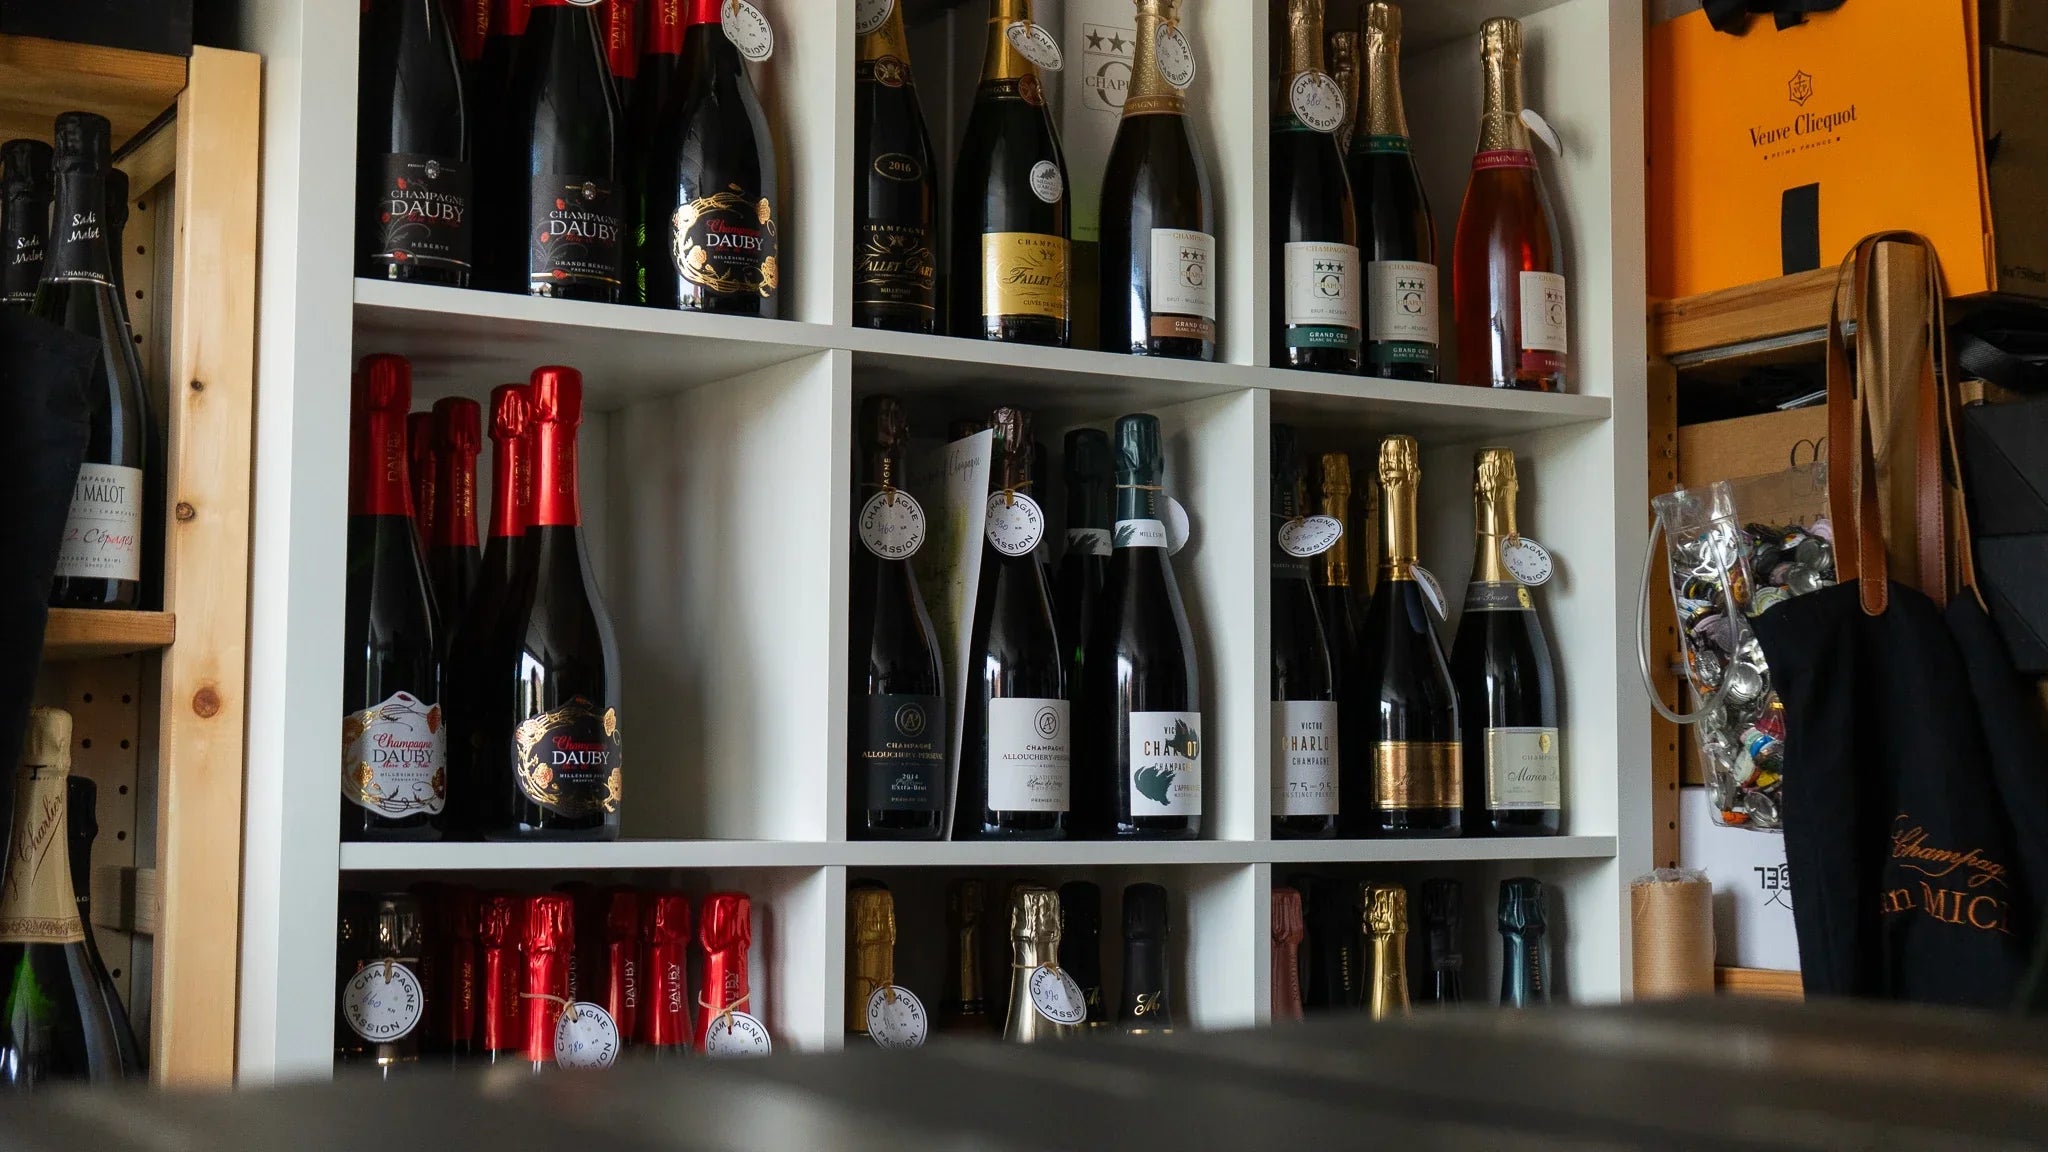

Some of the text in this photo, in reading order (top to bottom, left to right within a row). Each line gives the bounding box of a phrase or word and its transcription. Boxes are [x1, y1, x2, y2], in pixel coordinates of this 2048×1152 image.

[611, 2, 621, 49] DAUBY
[724, 3, 768, 34] CHPAGNE
[855, 7, 885, 30] SSION
[1157, 29, 1189, 61] CHAAGNE
[1160, 59, 1188, 81] PASSION
[1296, 77, 1341, 109] CHAAGNE
[1299, 105, 1337, 127] PASSION
[1749, 104, 1857, 148] Veuve Clicquot
[889, 161, 911, 172] 2016
[391, 190, 464, 206] CHAMPAGNE
[72, 211, 96, 226] Sadi
[391, 199, 464, 223] DAUBY
[549, 210, 617, 225] CHAMPAGNE
[16, 234, 40, 249] Sadi
[67, 227, 100, 243] Malot
[550, 220, 618, 242] DAUBY
[706, 233, 764, 251] DAUBY
[1017, 239, 1061, 249] CHAMPAG
[12, 250, 43, 265] Malot
[81, 475, 116, 483] MPAGNE
[883, 457, 891, 488] PAGNE
[84, 484, 125, 504] MALOT
[864, 497, 919, 530] CHAMAGNE
[987, 498, 1037, 524] CHAMAGNE
[65, 528, 134, 551] 2 Cépages
[1282, 518, 1335, 541] CHAAGNE
[874, 533, 919, 554] PASSION
[990, 531, 1034, 551] PASSION
[1292, 533, 1336, 552] PASSION
[1510, 565, 1547, 580] PASSION
[1301, 722, 1322, 730] VICTOR
[373, 732, 432, 752] Champagne
[886, 742, 932, 750] CHAMPAGNE
[373, 749, 434, 763] DAUBY
[551, 751, 610, 765] DAUBY
[1292, 757, 1329, 765] CHAMPAGNE
[1508, 766, 1547, 782] Marion
[354, 969, 414, 1012] CHAPAGNE
[625, 959, 635, 1008] DAUBY
[669, 961, 679, 1013] DAUBY
[725, 969, 736, 1002] UBY
[871, 990, 920, 1021] CHAAGNE
[1045, 1004, 1081, 1018] PASSION
[350, 1004, 400, 1034] PASSION
[558, 1009, 609, 1051] CHAMAGNE
[709, 1020, 763, 1052] CHAMAGNE
